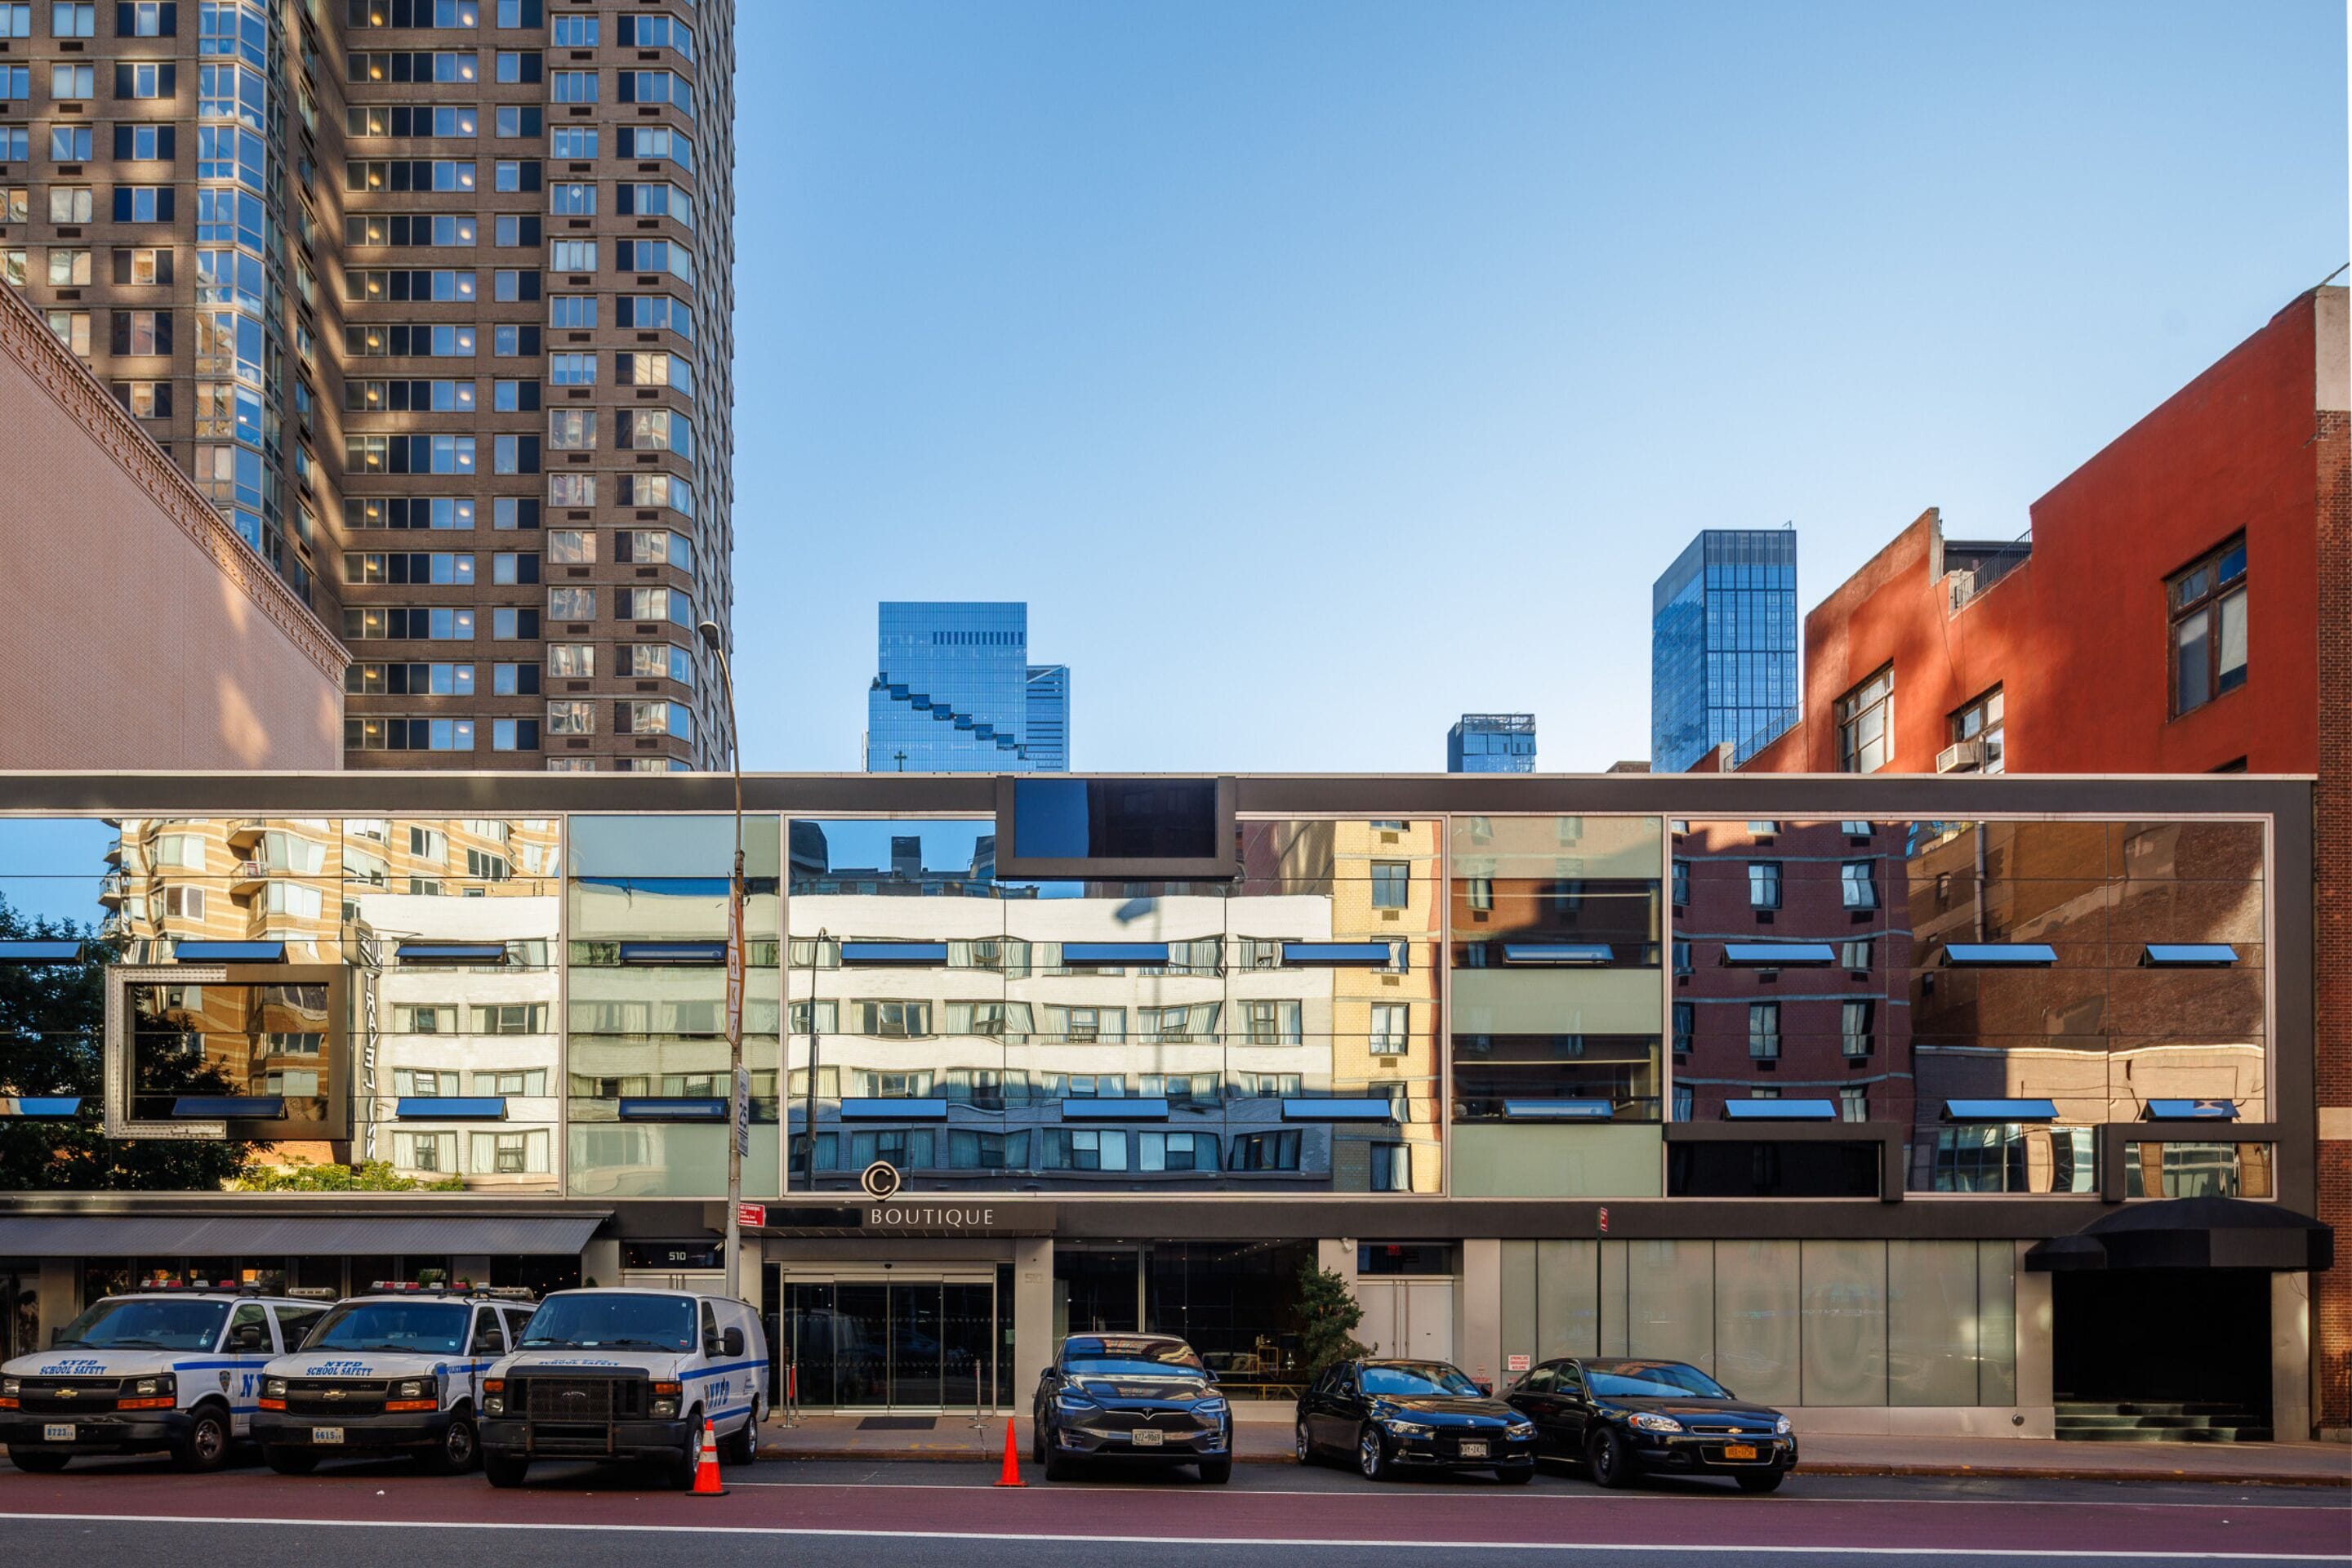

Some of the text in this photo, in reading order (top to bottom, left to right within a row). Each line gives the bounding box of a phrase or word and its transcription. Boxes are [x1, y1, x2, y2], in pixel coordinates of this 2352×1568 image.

[739, 1102, 747, 1129] 25
[869, 1168, 891, 1193] C
[871, 1209, 993, 1227] BOUTIQUE
[669, 1252, 686, 1260] 510
[39, 1366, 107, 1374] SCHOOL SAFETY
[306, 1367, 373, 1376] SCHOOL SAFETY
